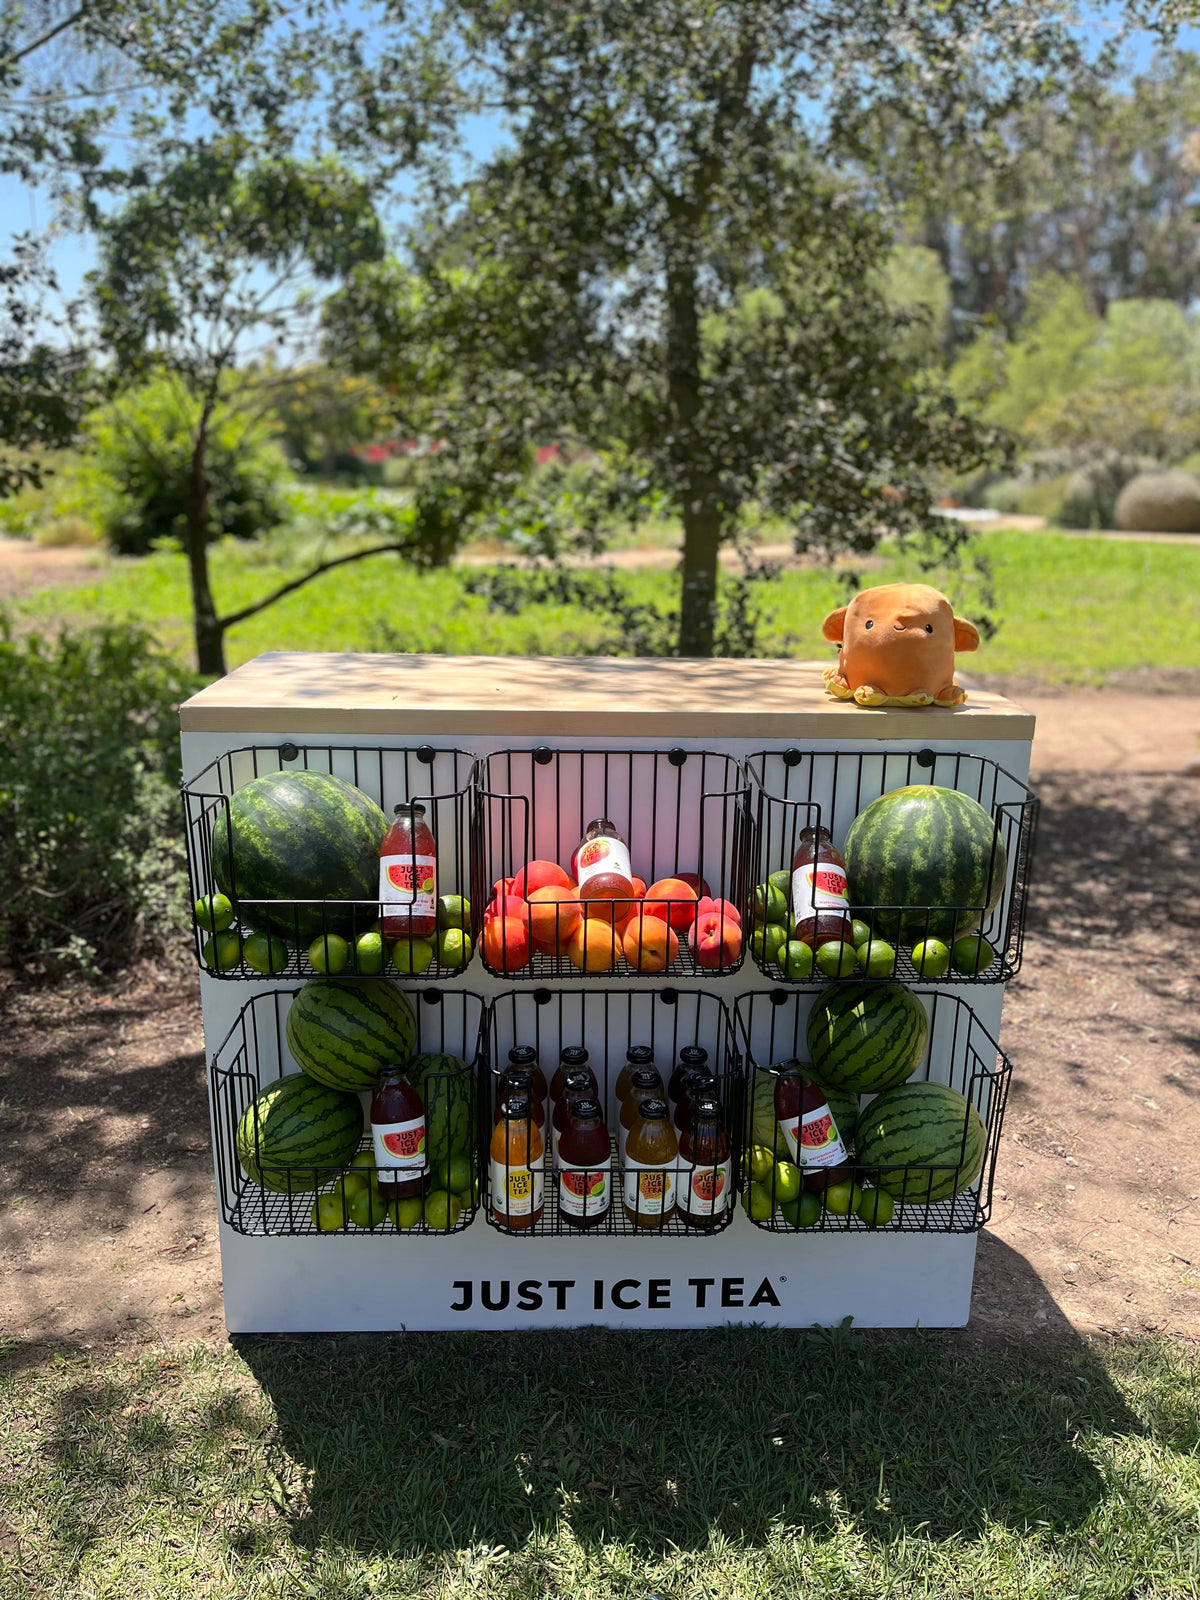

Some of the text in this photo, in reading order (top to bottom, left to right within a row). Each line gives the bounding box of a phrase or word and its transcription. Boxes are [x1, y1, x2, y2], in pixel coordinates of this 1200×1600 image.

[823, 872, 843, 882] JUST
[827, 879, 841, 888] ICE
[827, 886, 842, 895] TEA
[803, 1119, 824, 1133] JUST
[396, 1130, 418, 1141] JUST
[809, 1128, 824, 1139] ICE
[400, 1139, 416, 1148] ICE
[811, 1136, 827, 1146] TEA
[401, 1147, 417, 1155] TEA
[510, 1173, 531, 1182] JUST
[450, 1280, 576, 1311] JUST
[593, 1279, 672, 1310] ICE
